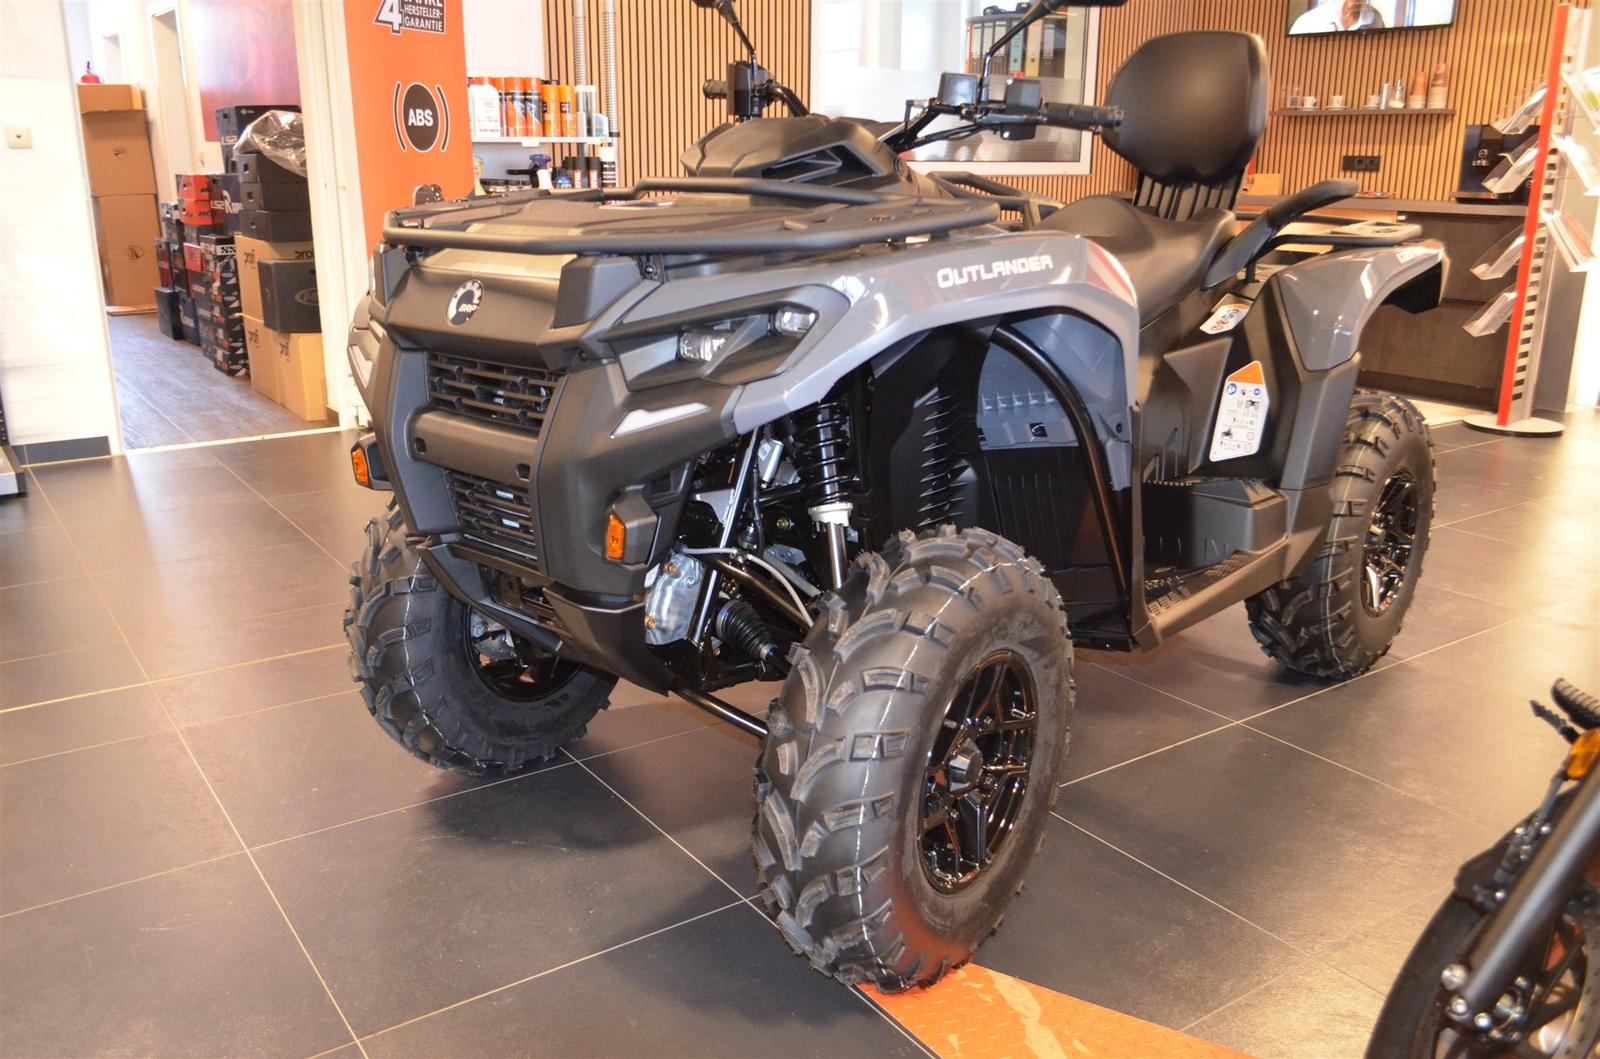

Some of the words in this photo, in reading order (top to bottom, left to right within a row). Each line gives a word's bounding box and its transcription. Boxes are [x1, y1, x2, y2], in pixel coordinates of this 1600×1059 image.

[404, 4, 443, 18] HERSTELLER-
[404, 16, 443, 31] GARANTIE
[408, 108, 434, 127] ABS
[936, 255, 1054, 289] OUTLANDER
[458, 303, 478, 313] BRP
